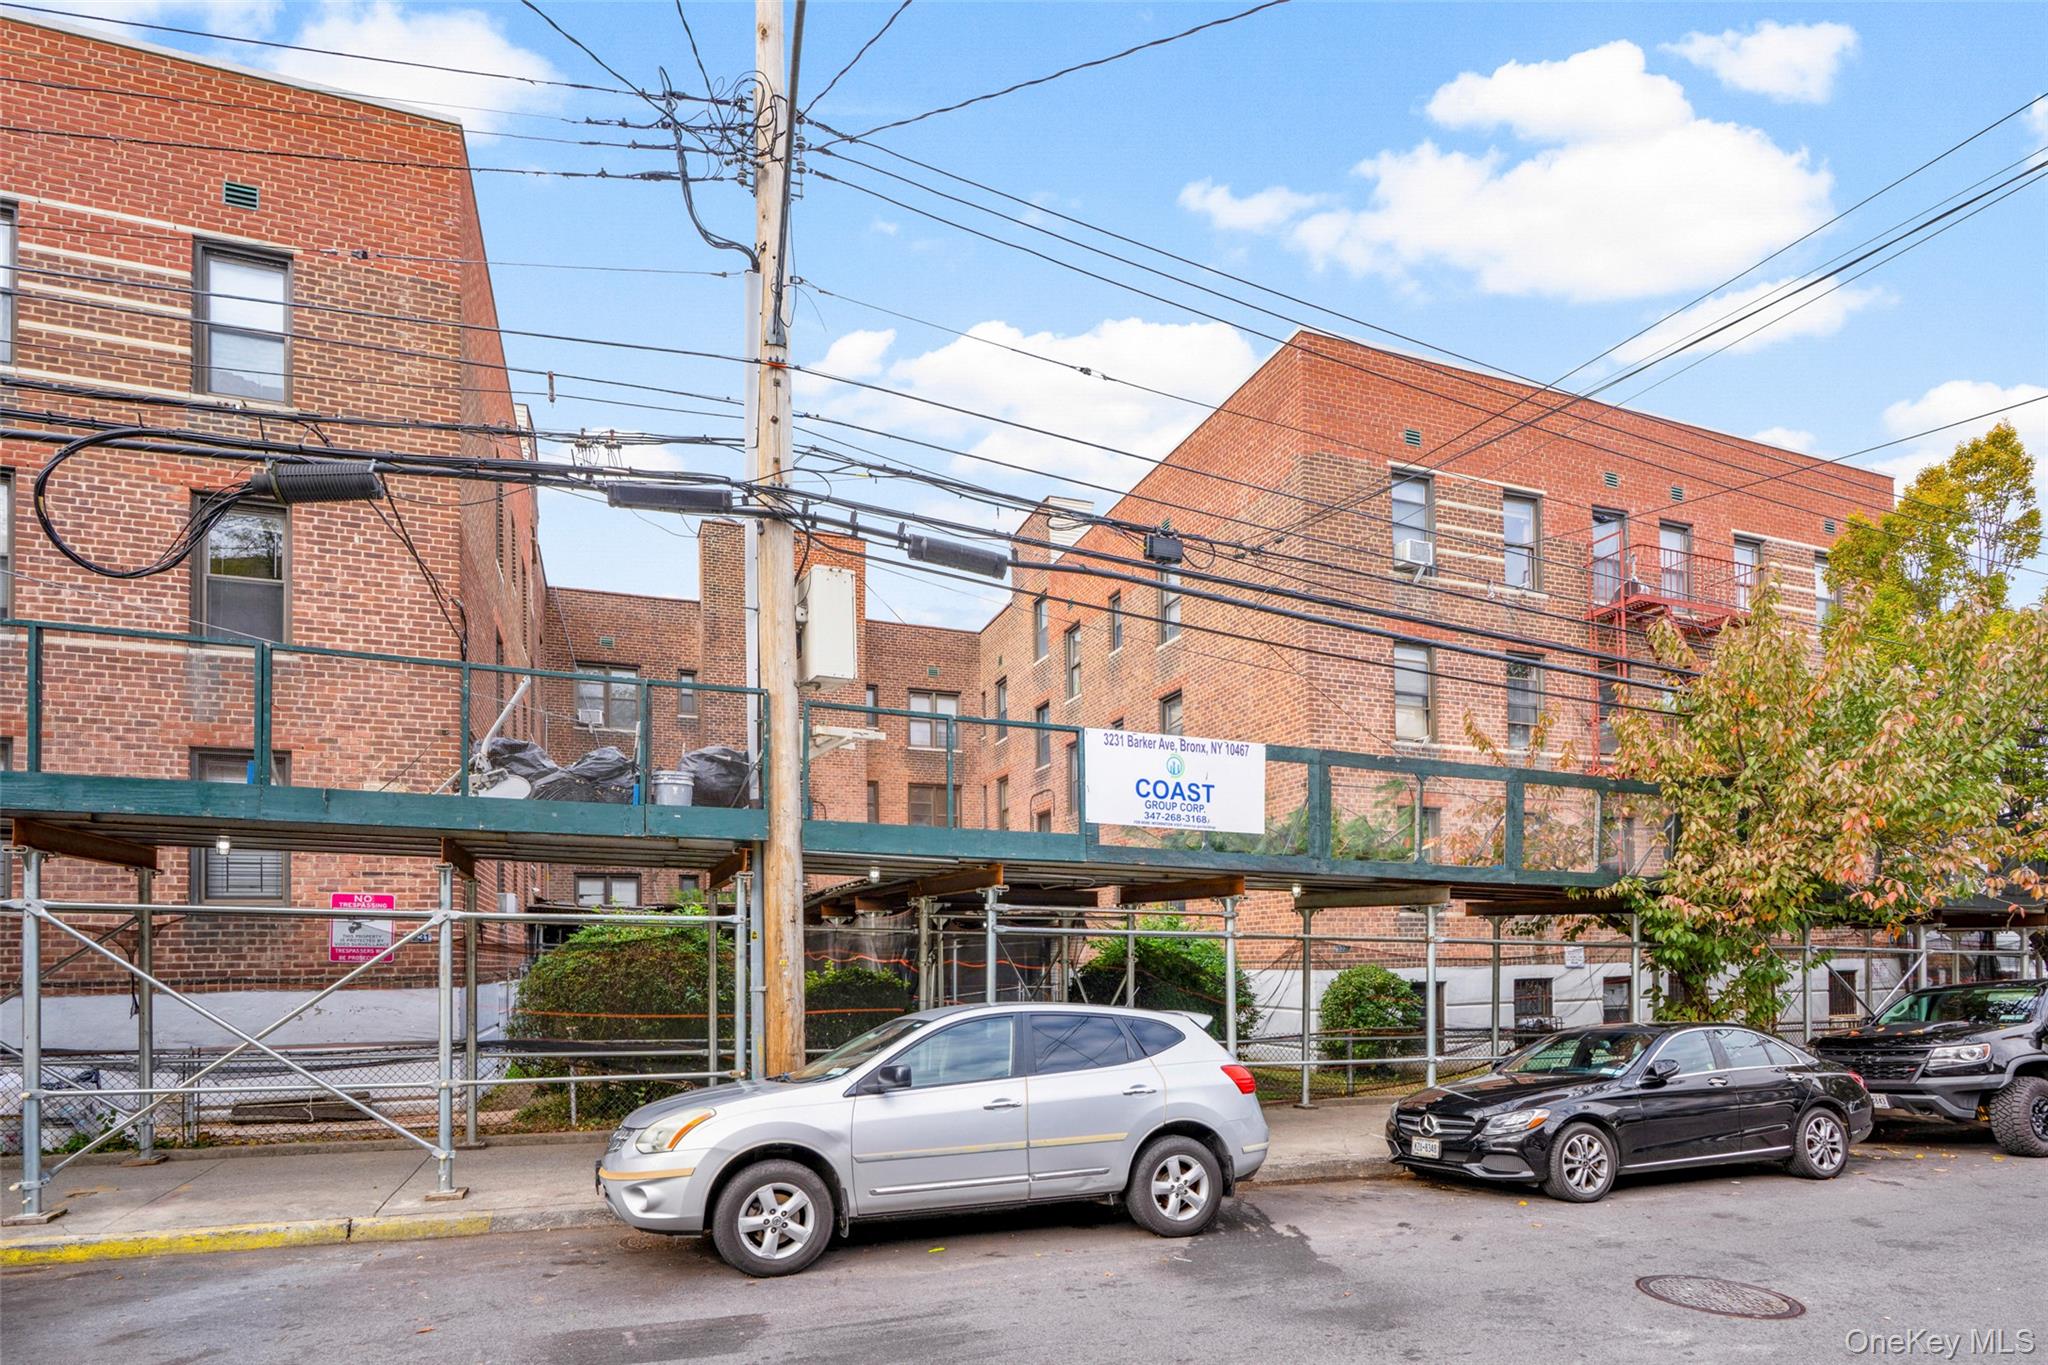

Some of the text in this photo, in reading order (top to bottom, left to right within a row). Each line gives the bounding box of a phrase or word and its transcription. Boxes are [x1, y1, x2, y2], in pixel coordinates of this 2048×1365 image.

[1103, 732, 1249, 757] 3231 Barker Ave, Bronx, NY 10467
[1135, 778, 1215, 803] COAST
[1144, 800, 1206, 813] GROUP CORP.
[1144, 811, 1207, 823] 347-268-3168
